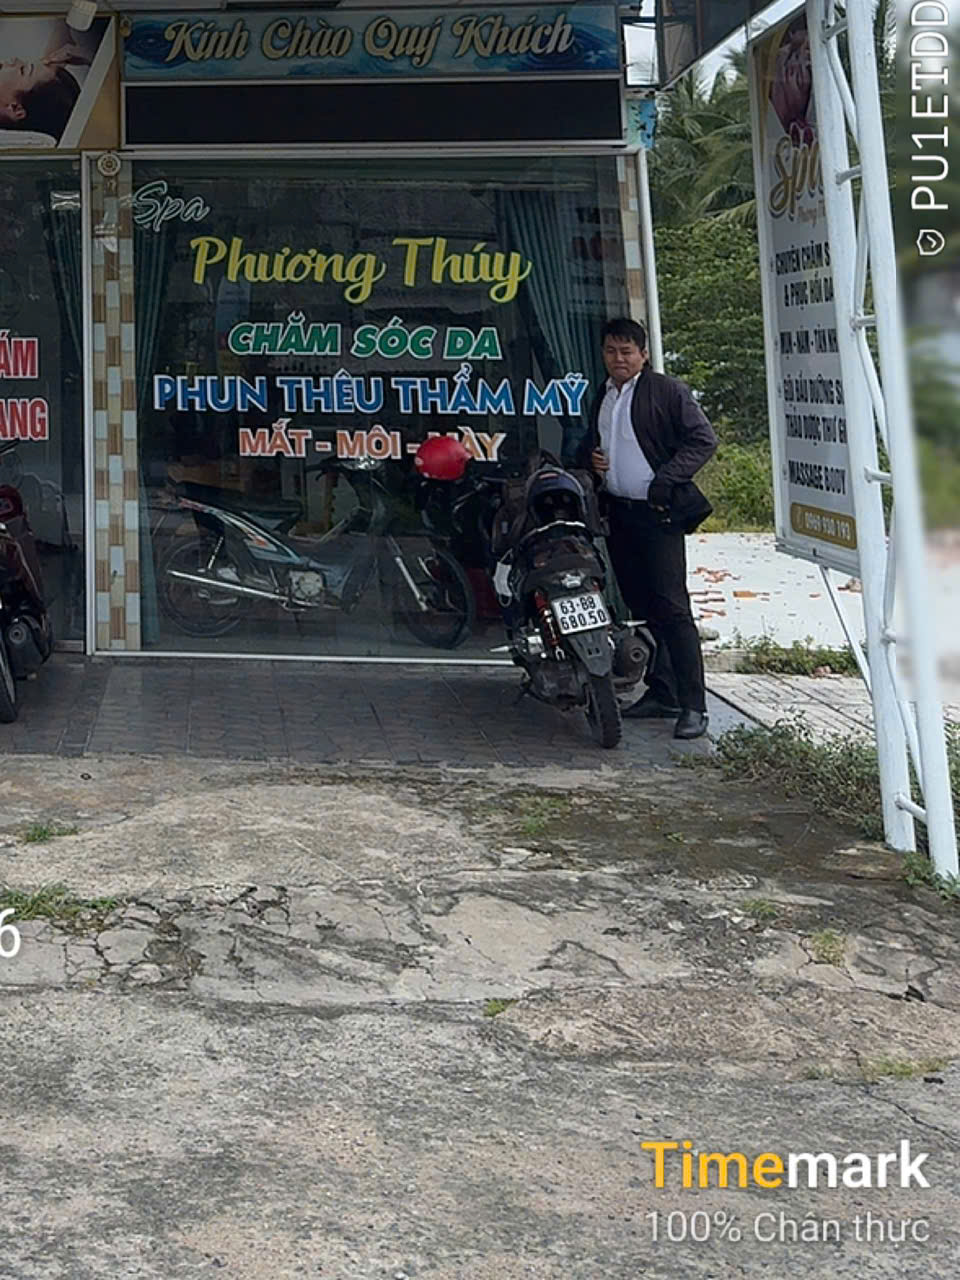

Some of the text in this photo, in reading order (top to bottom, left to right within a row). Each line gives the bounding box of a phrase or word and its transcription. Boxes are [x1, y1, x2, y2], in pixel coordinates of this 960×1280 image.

[164, 13, 574, 68] Kính Chào Quý Khách
[132, 179, 210, 232] Spa
[190, 235, 387, 304] Phương
[392, 235, 532, 304] Thúy
[228, 311, 502, 360] CHĂM SÓC DA
[152, 364, 589, 416] PHUN THÊU THẨM MỸ
[239, 418, 314, 459] MẮT
[336, 424, 402, 460] MÔI
[427, 425, 508, 462] ÀY
[788, 459, 846, 495] MASSAGE BODY
